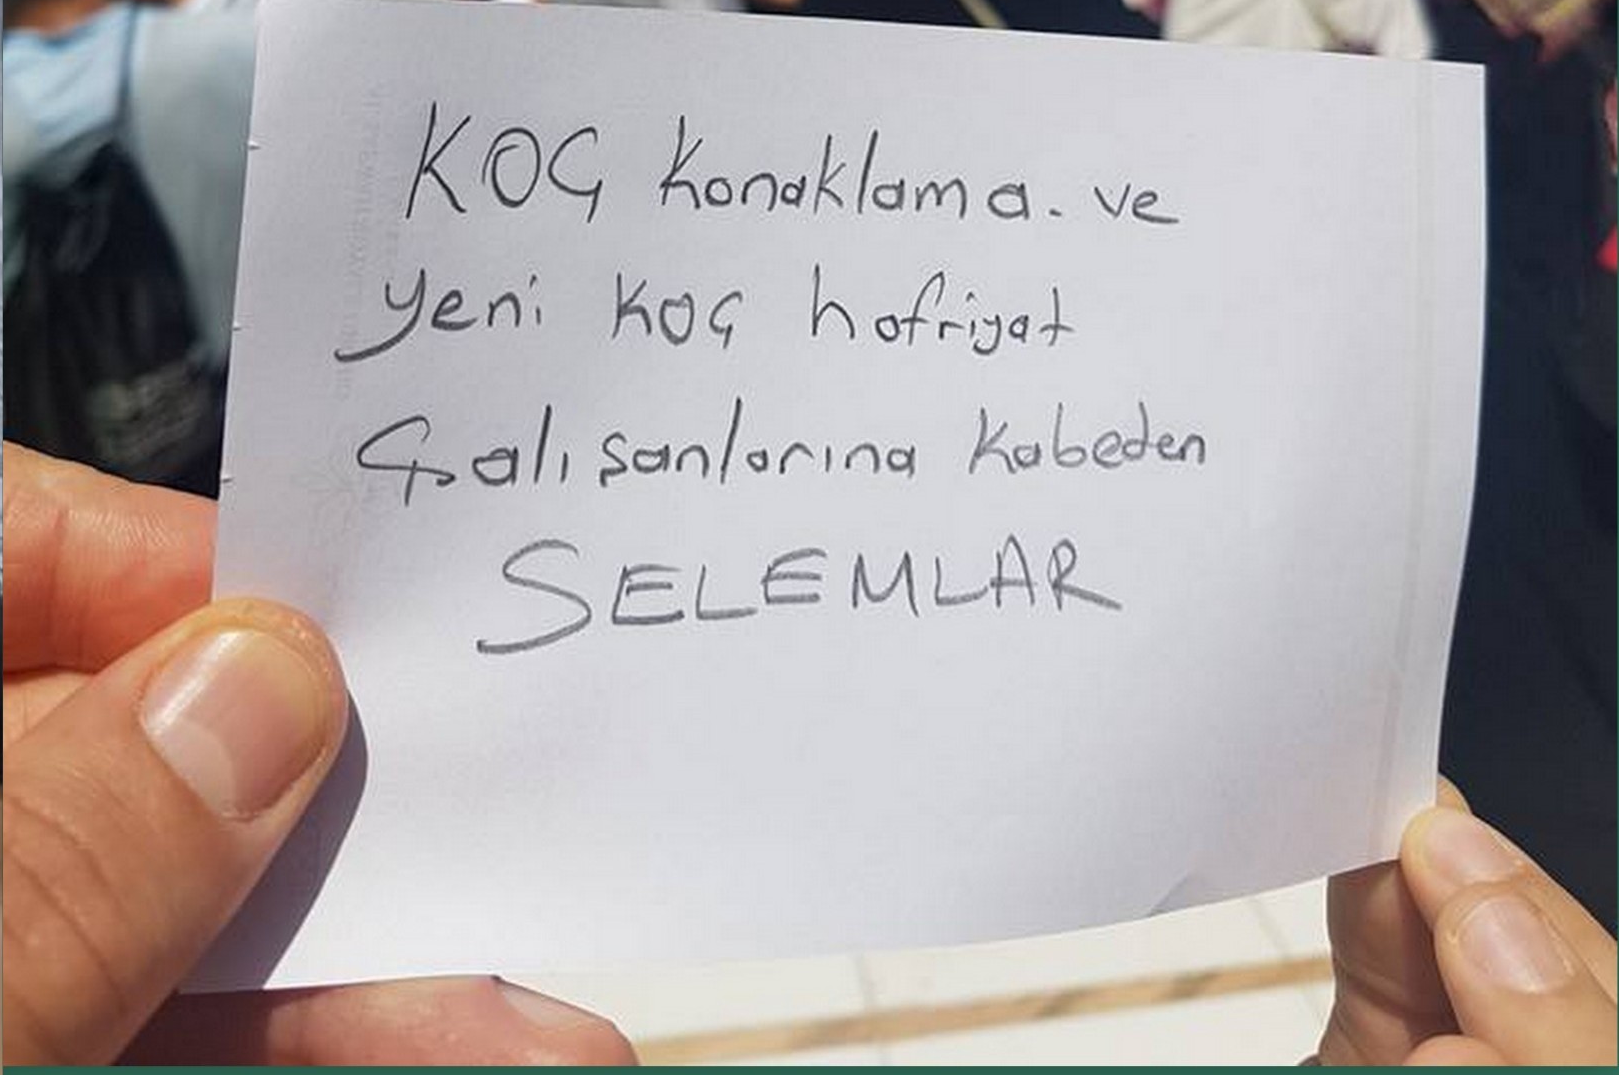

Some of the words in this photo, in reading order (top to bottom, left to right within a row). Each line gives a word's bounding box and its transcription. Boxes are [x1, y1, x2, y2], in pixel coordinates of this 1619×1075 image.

[405, 100, 604, 225] KOÇ
[1093, 182, 1181, 225] ve
[475, 533, 1123, 656] SELEMLAR
